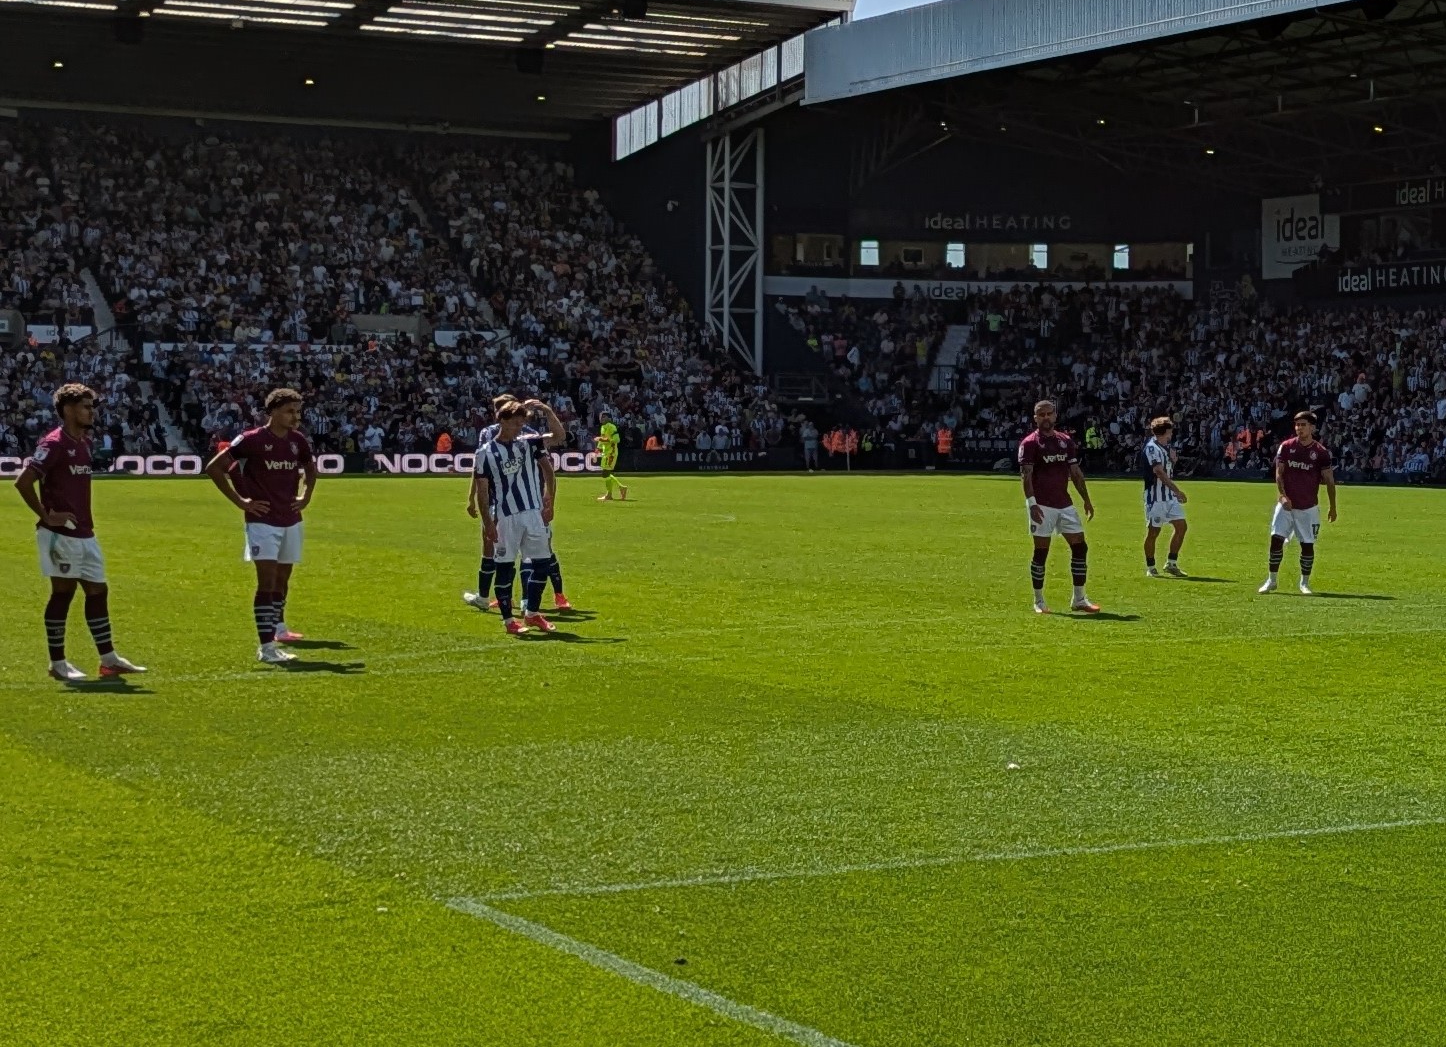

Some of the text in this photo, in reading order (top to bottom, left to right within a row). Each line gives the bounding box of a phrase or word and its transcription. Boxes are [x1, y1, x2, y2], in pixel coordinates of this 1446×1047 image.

[1396, 179, 1431, 205] ideal
[925, 213, 1072, 230] ideal HEATING
[1274, 207, 1325, 243] ideal
[1337, 266, 1372, 293] ideal
[927, 282, 968, 299] ideal
[109, 455, 202, 475] OCO
[265, 459, 296, 470] Vertu
[676, 452, 754, 462] MARC DARCY
[1287, 459, 1311, 471] Vertu
